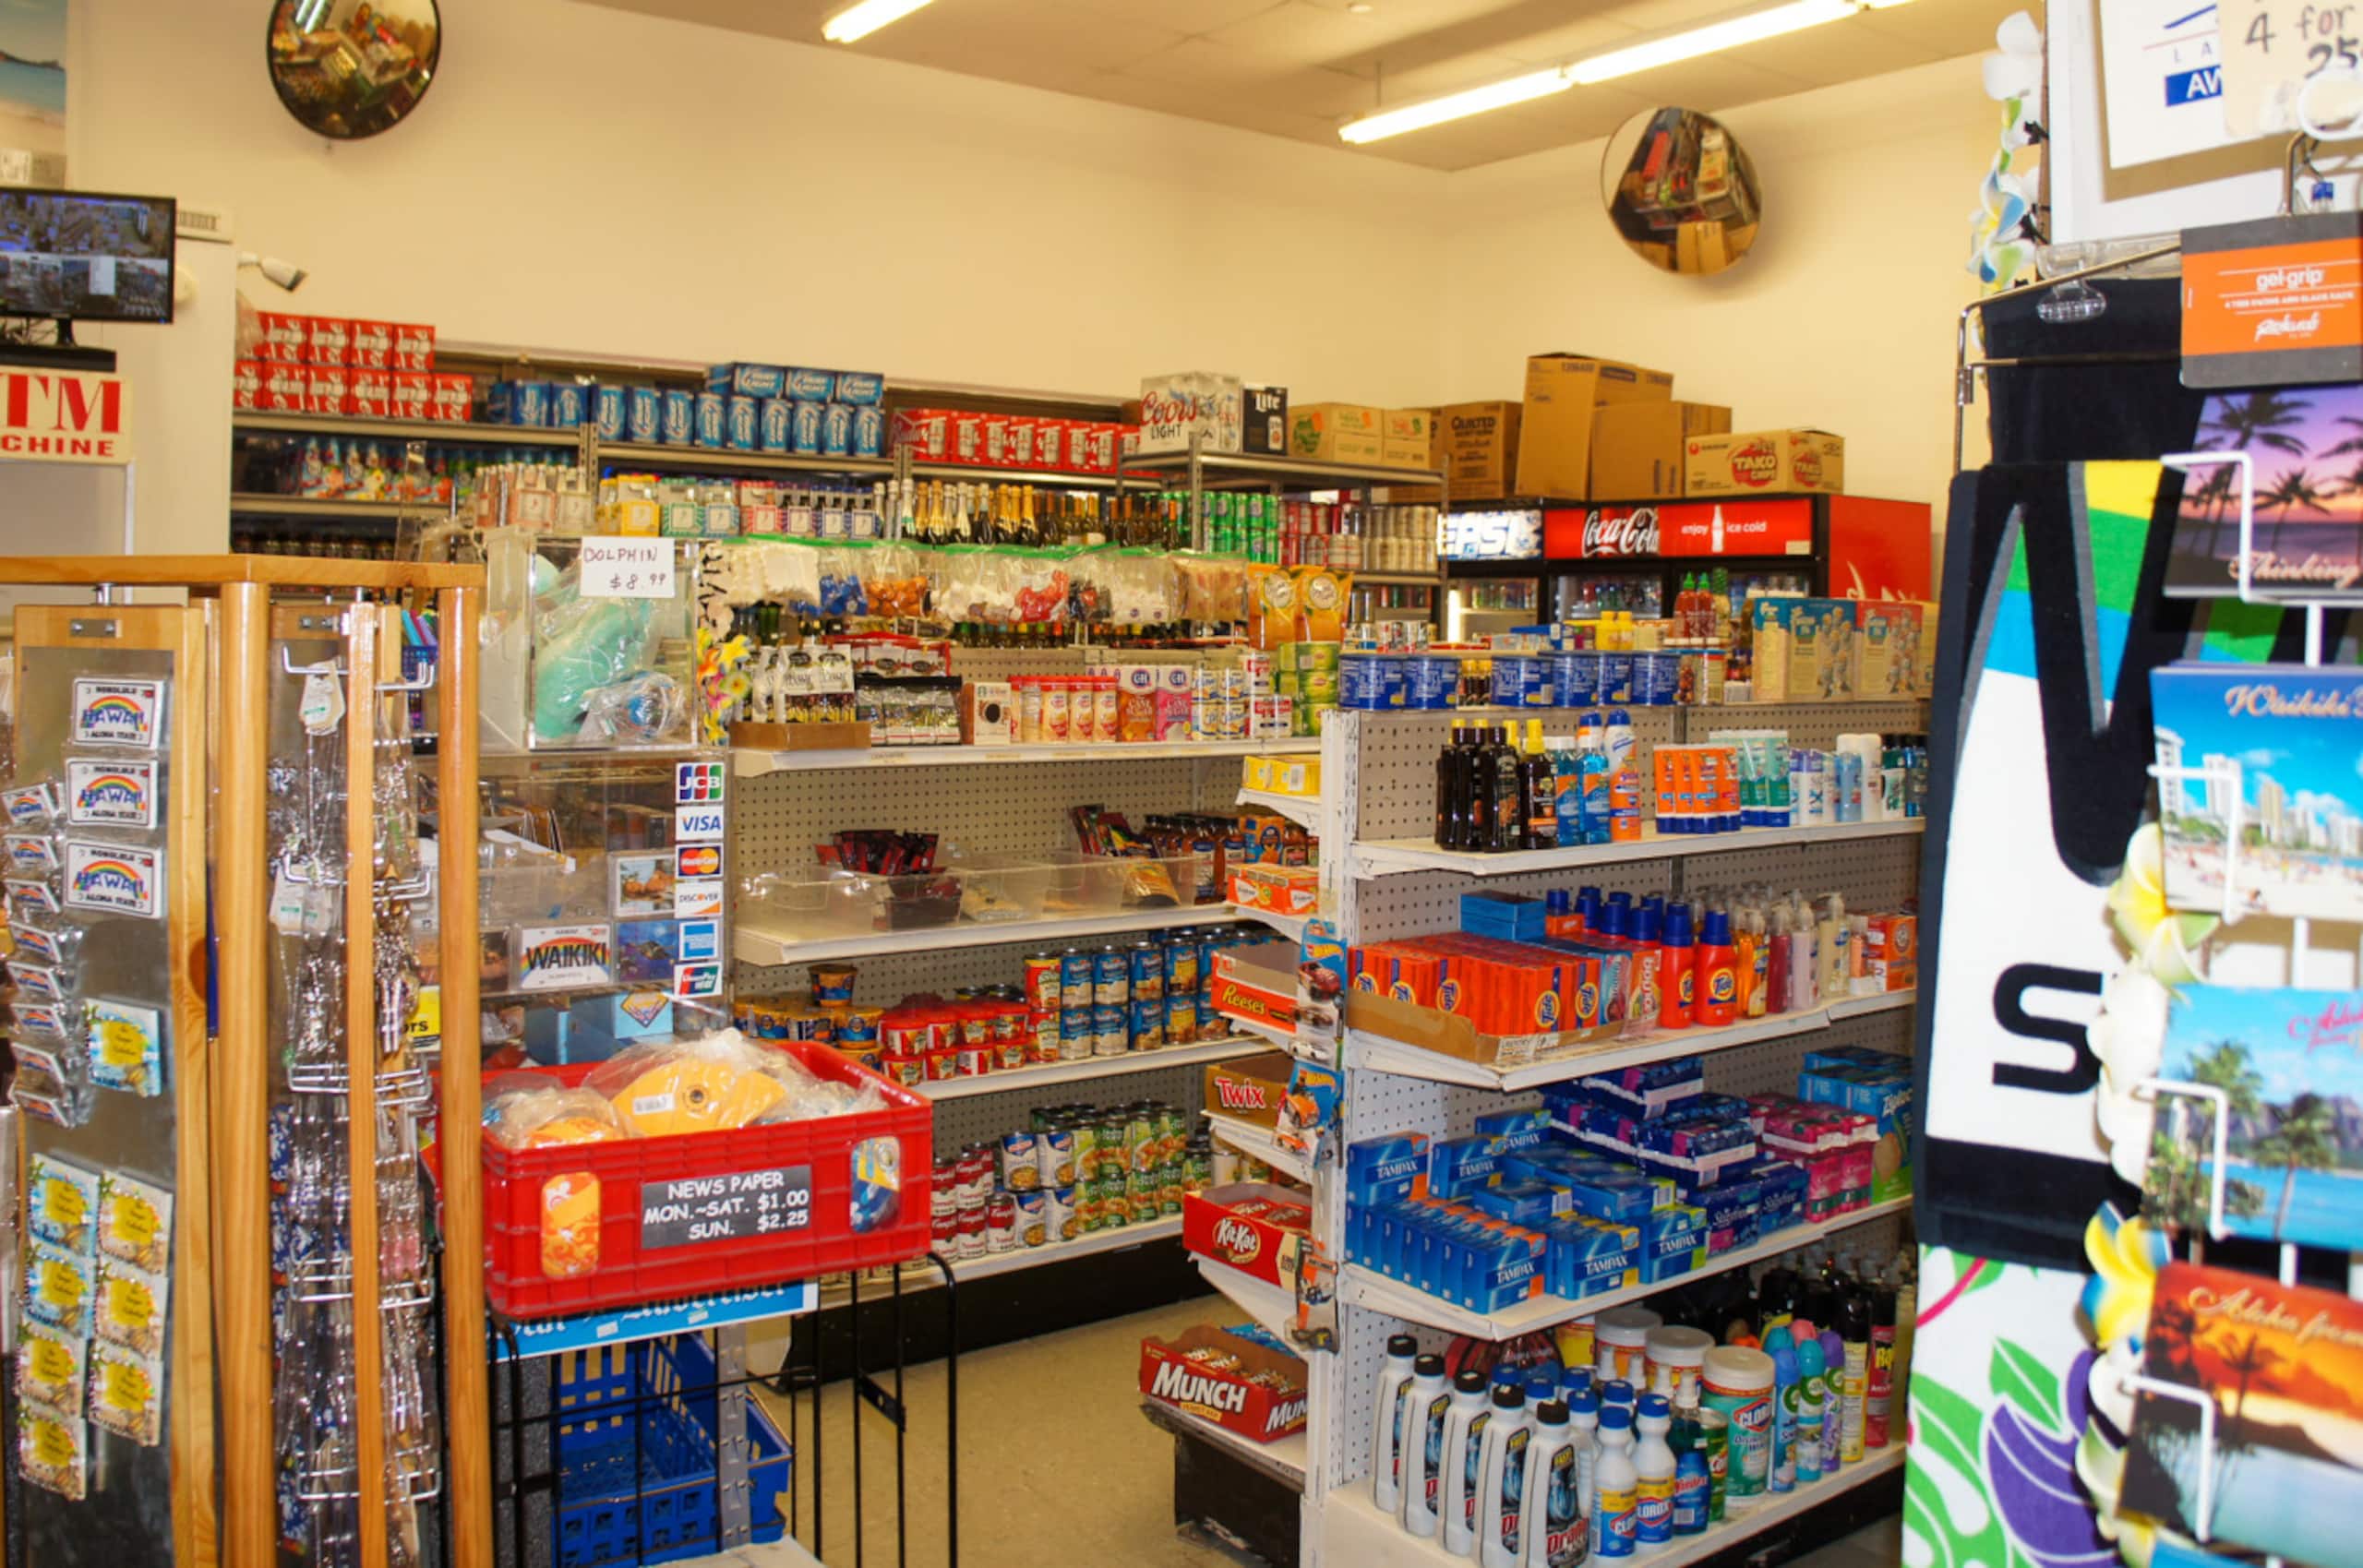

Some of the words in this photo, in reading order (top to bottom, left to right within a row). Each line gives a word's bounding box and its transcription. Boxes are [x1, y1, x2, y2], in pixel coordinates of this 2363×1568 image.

[2245, 11, 2276, 53] 4
[2295, 5, 2355, 41] for
[2305, 35, 2363, 79] 25
[1139, 390, 1197, 426] Coors
[1254, 392, 1281, 413] Lite
[1151, 424, 1182, 440] LIGHT
[1, 434, 114, 457] CHINE
[1733, 455, 1776, 469] TAKO
[1436, 514, 1521, 557] EPSI
[1681, 524, 1709, 535] enjoy
[1726, 522, 1741, 533] ice
[1743, 521, 1768, 533] cold
[583, 545, 658, 563] DOLPHIN
[682, 816, 721, 832] VISA
[679, 892, 719, 904] DISCOVER
[526, 942, 606, 970] WAIKIKI
[1712, 976, 1734, 994] Tide
[1215, 1077, 1266, 1109] Twix
[1377, 1160, 1419, 1180] TAMPAX
[1458, 1159, 1495, 1179] TAMPAX
[668, 1179, 726, 1200] NEWS
[730, 1171, 785, 1193] PAPER
[757, 1189, 809, 1214] $1.00
[689, 1220, 736, 1240] SUN.
[756, 1209, 809, 1233] $2.25
[1659, 1232, 1698, 1253] TAMPAX
[1496, 1262, 1536, 1284] TAMPAX
[1586, 1254, 1628, 1275] TAMPAX
[2189, 1287, 2298, 1332] Aloha
[1152, 1360, 1247, 1413] MUNCH
[1265, 1398, 1307, 1432] MUN
[1637, 1500, 1671, 1520] LOROX
